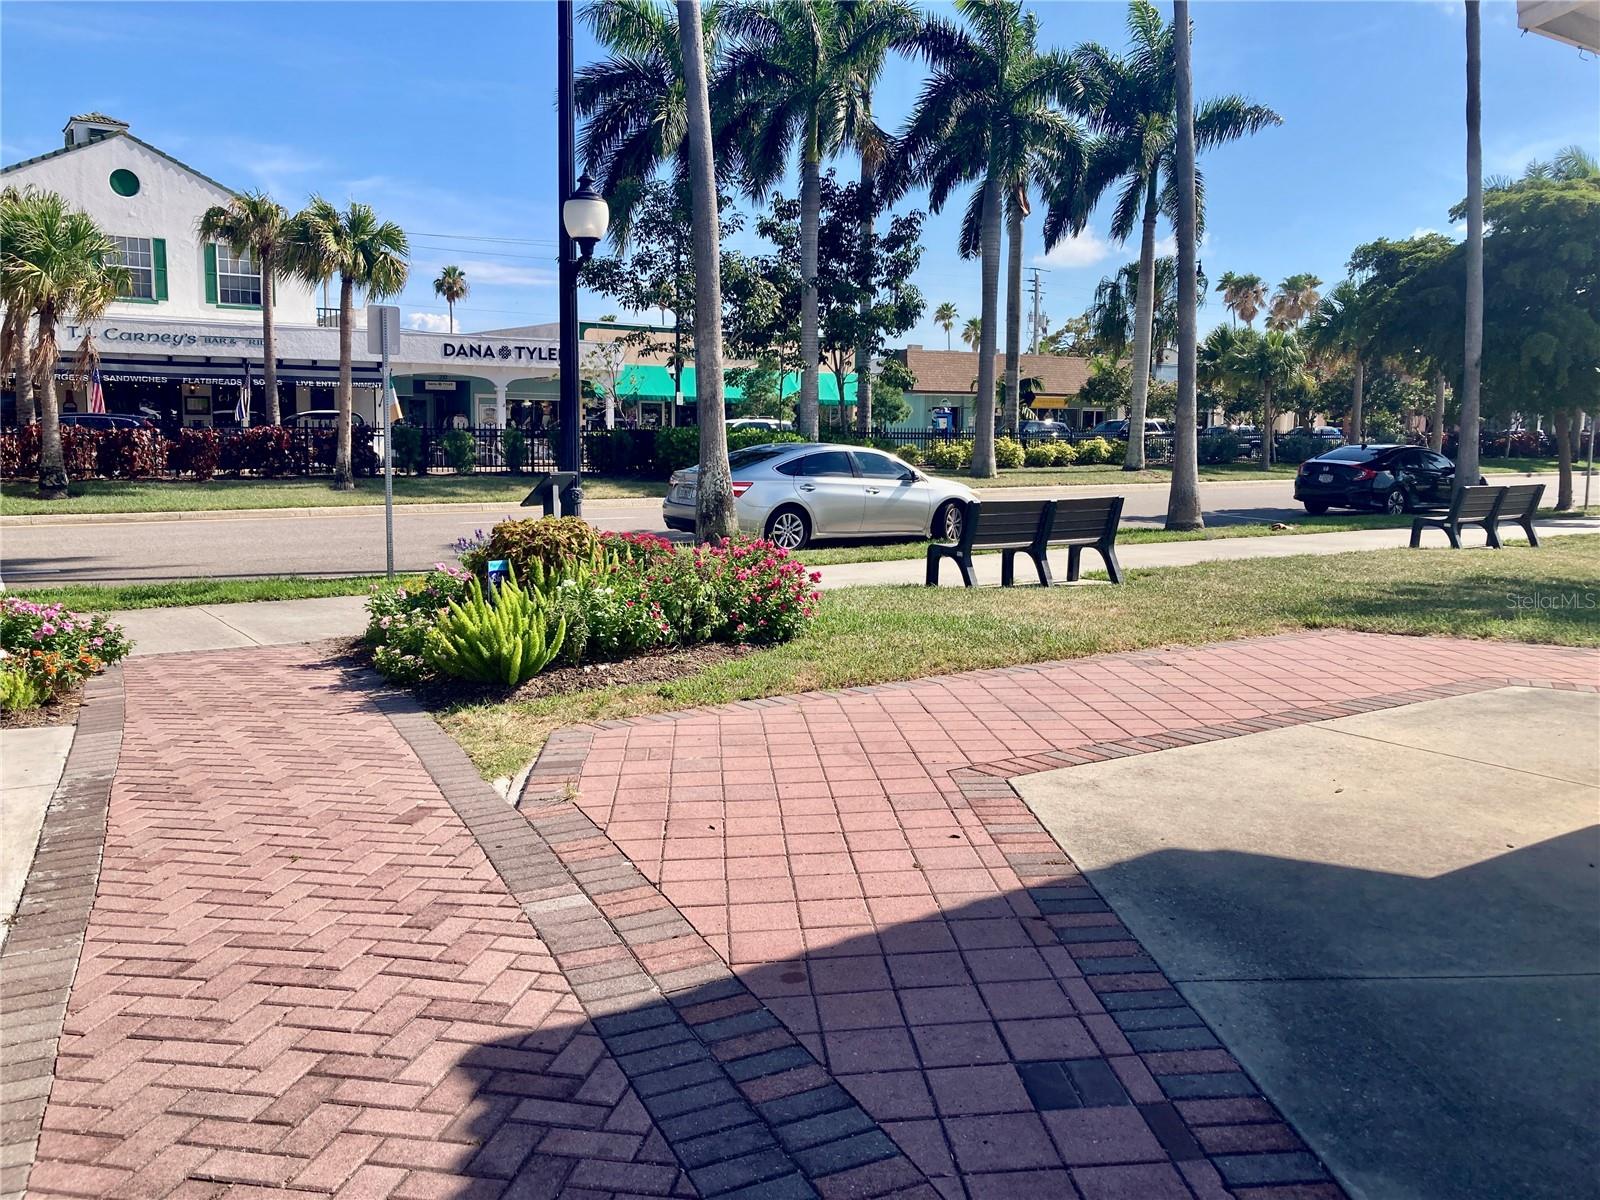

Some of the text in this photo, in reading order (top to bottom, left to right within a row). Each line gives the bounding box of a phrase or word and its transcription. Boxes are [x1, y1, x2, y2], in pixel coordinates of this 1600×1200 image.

[104, 328, 197, 346] Carney's
[204, 337, 227, 345] BAR
[443, 343, 495, 358] DANA
[103, 374, 168, 383] SANDWICHES
[183, 377, 243, 386] FLATBREADS
